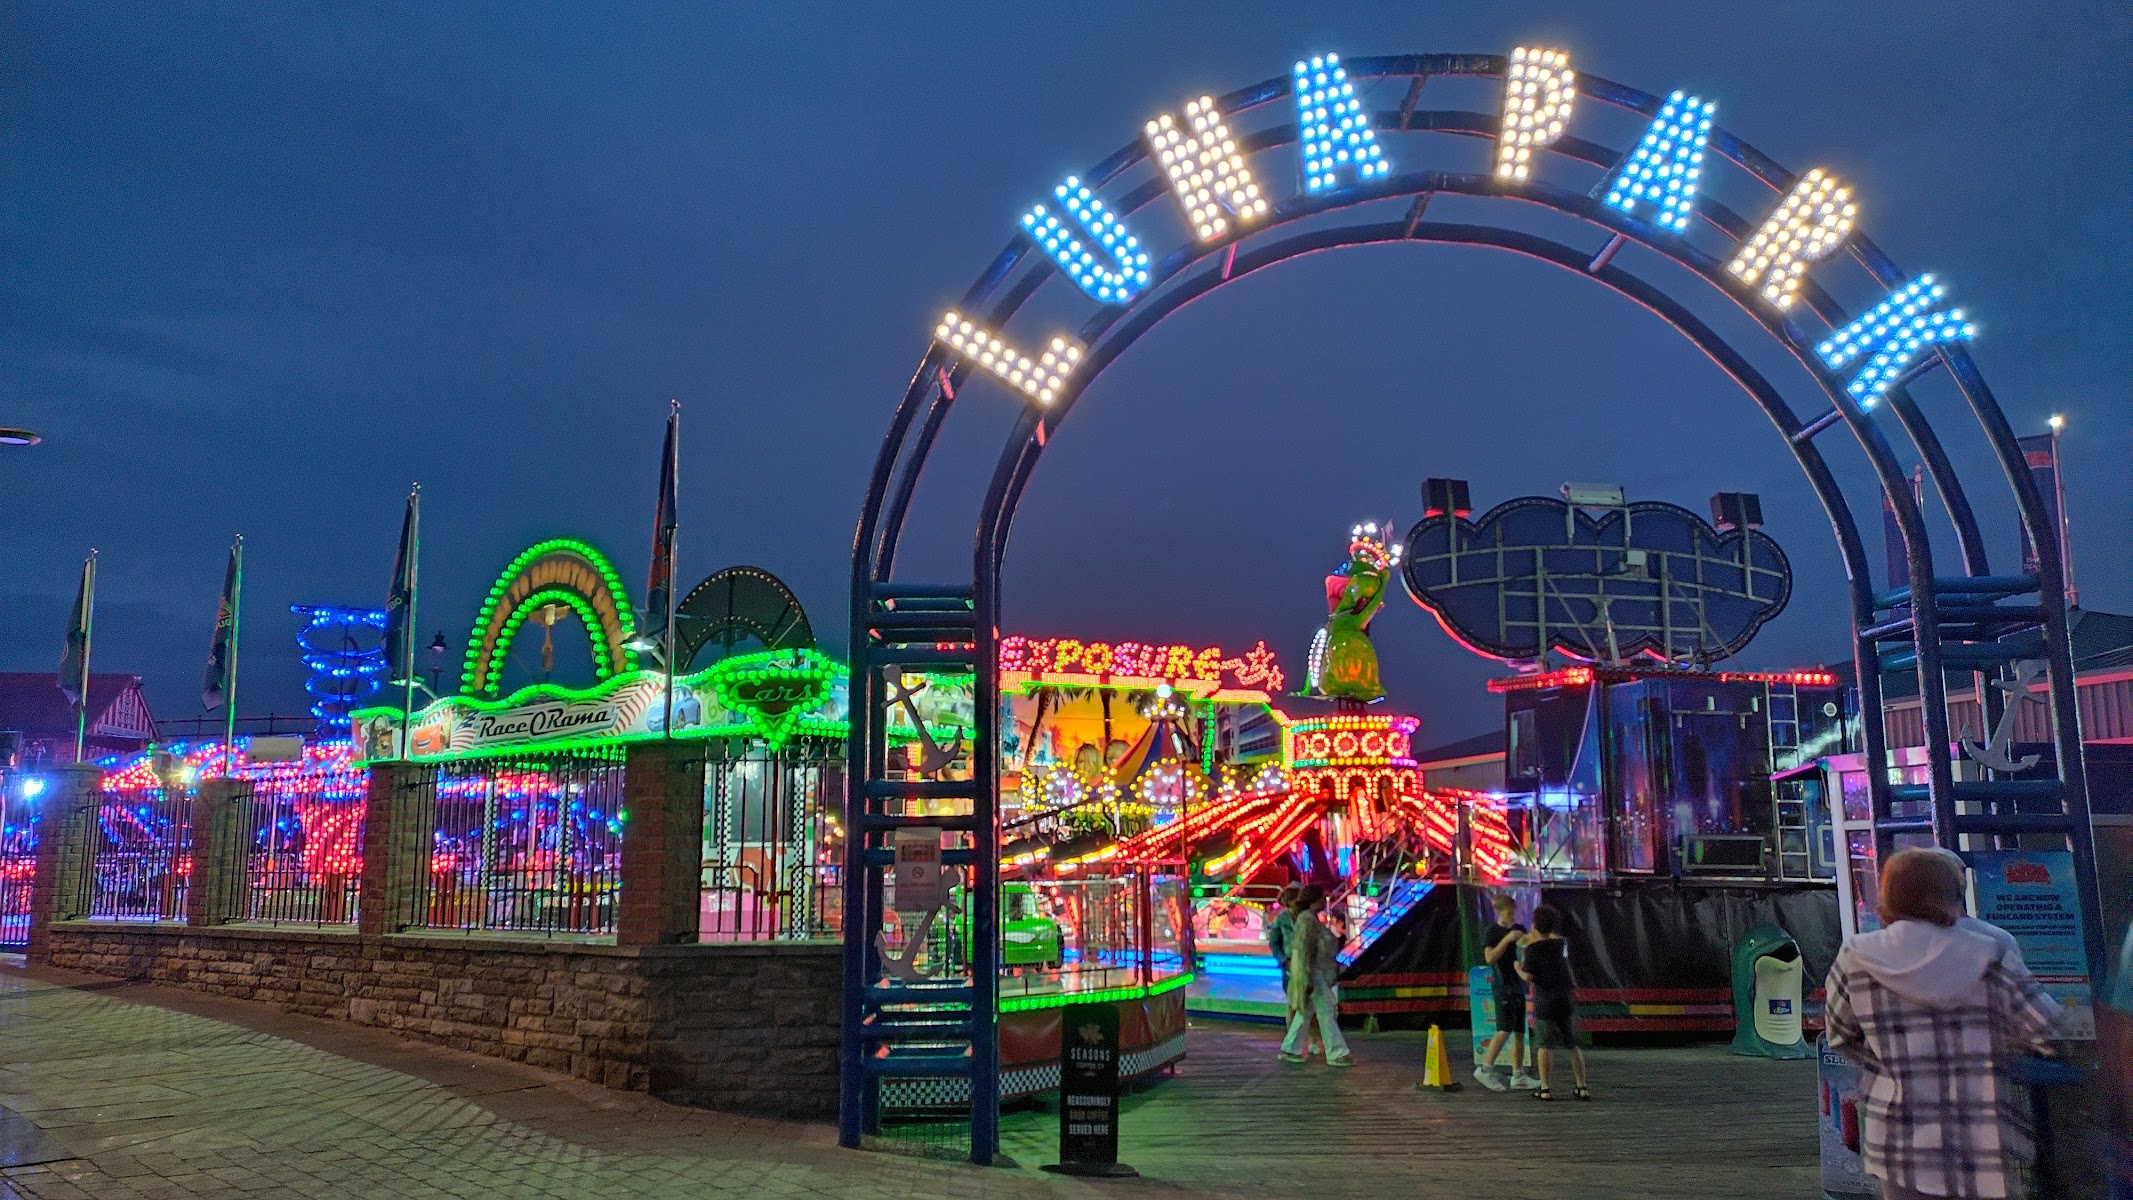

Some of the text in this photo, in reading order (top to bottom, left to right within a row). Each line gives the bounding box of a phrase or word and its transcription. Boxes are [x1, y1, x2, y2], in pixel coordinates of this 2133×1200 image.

[934, 45, 1979, 413] LUNA PARK
[998, 635, 1221, 680] EXPOSURE
[729, 678, 816, 703] Cars
[1071, 1047, 1110, 1062] SEASONS
